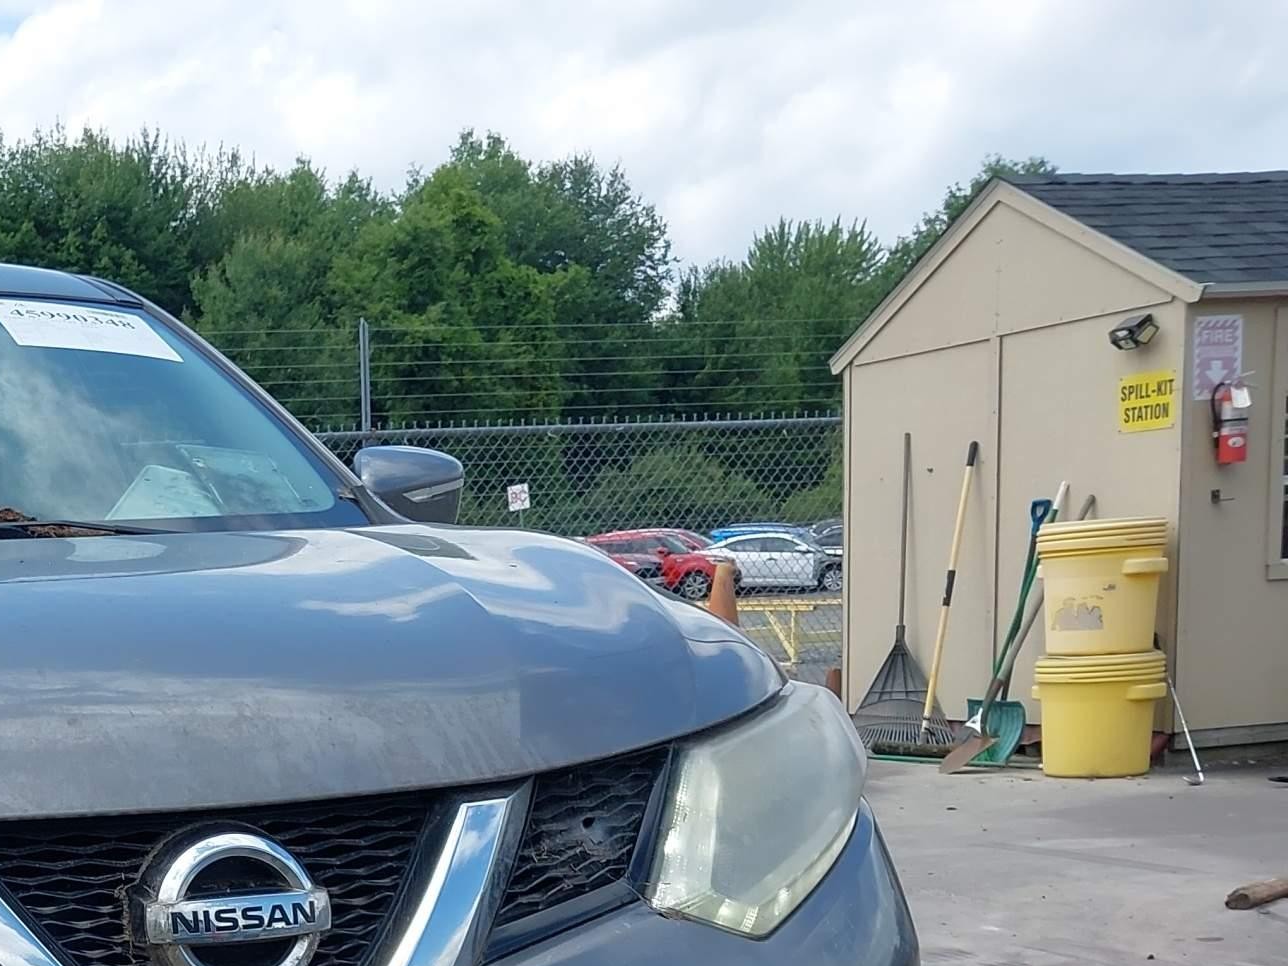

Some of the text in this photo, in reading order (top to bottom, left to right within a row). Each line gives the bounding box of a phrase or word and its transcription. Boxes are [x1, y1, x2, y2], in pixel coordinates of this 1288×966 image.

[1201, 329, 1233, 344] FIRE
[1120, 378, 1175, 403] SPILL-KIT
[1123, 402, 1169, 424] STATION
[171, 900, 317, 935] NISSAN
